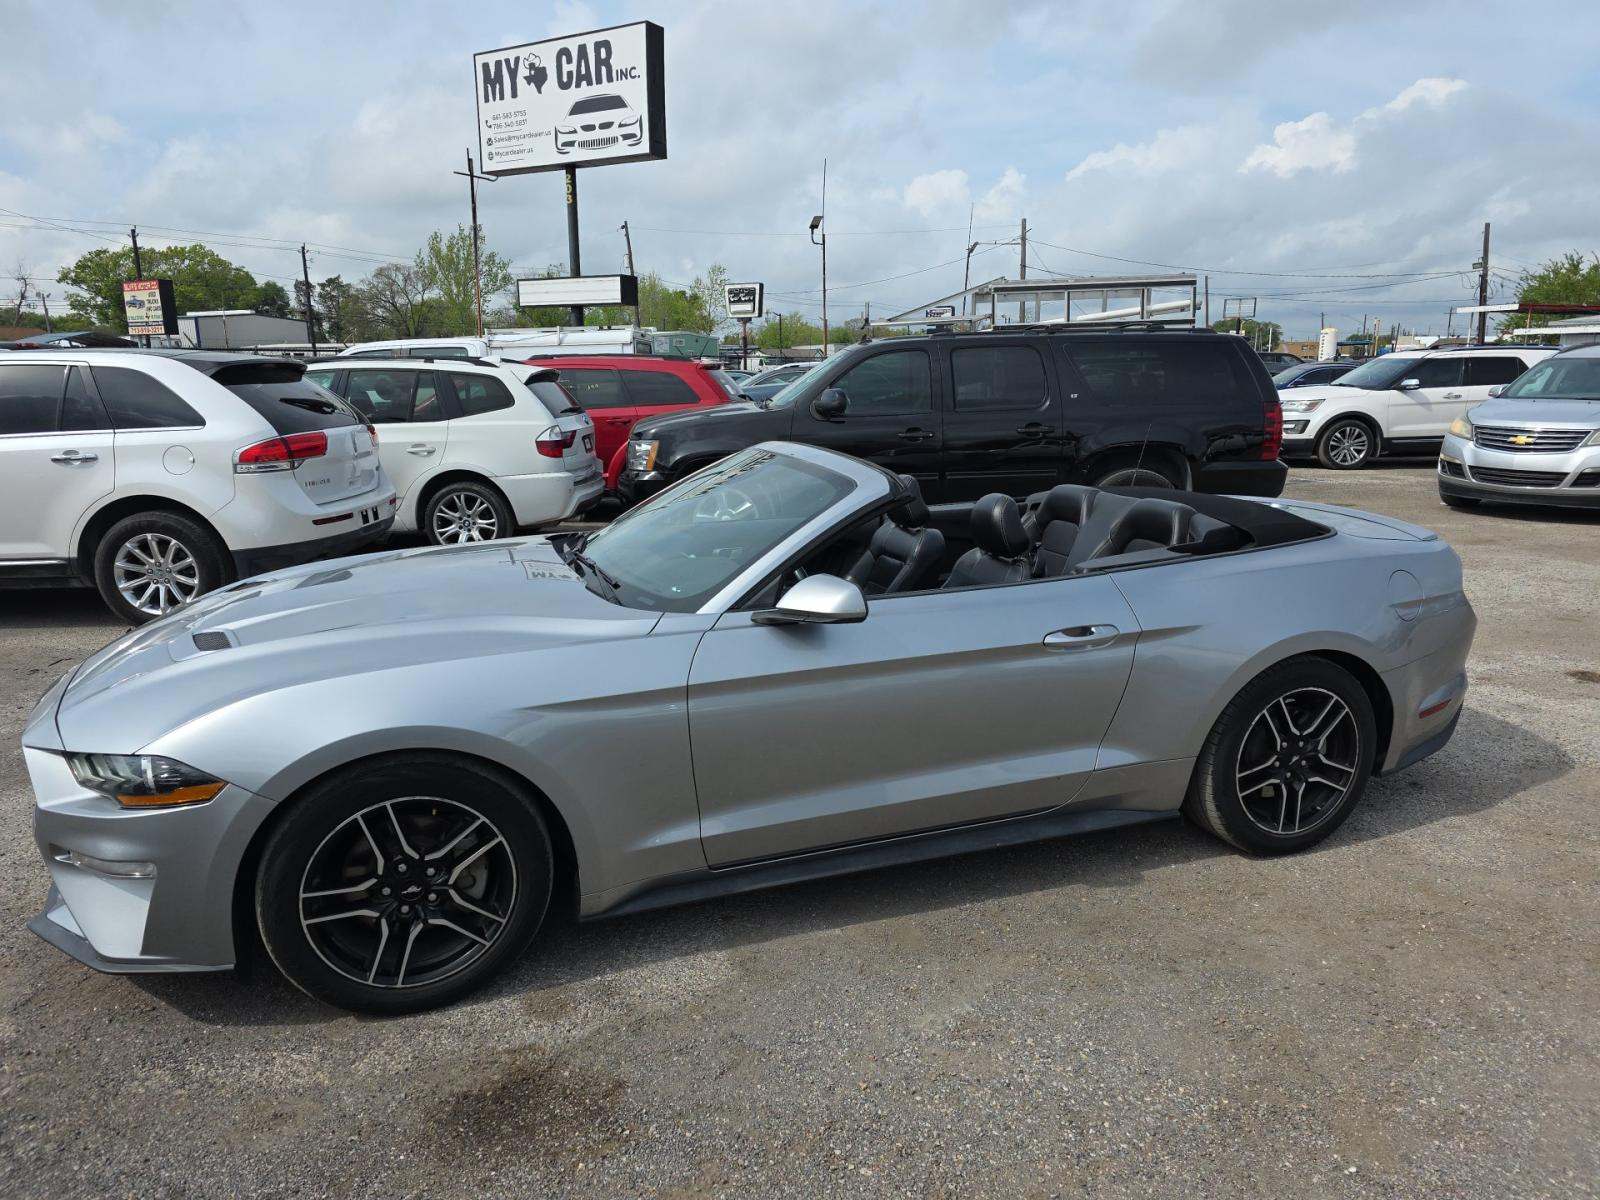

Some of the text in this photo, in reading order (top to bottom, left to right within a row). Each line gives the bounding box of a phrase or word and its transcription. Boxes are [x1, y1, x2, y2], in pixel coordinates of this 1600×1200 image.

[482, 39, 641, 103] MY CAR INC.
